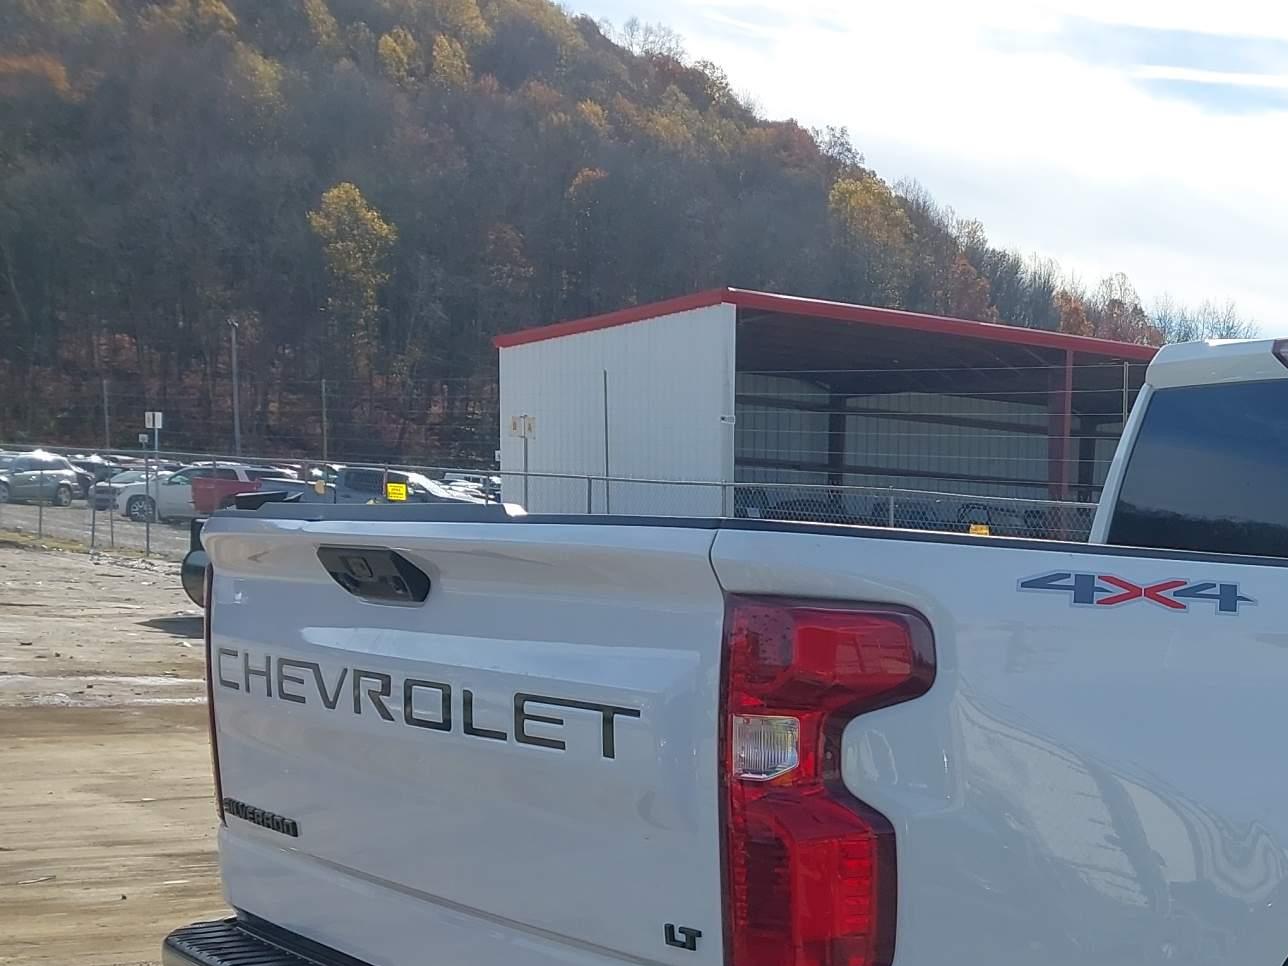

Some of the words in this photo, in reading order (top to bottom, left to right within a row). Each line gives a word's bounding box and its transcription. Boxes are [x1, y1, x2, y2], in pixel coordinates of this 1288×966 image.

[217, 647, 641, 759] CHEVROLET
[223, 797, 298, 837] SILVERADO
[664, 923, 702, 951] LT
